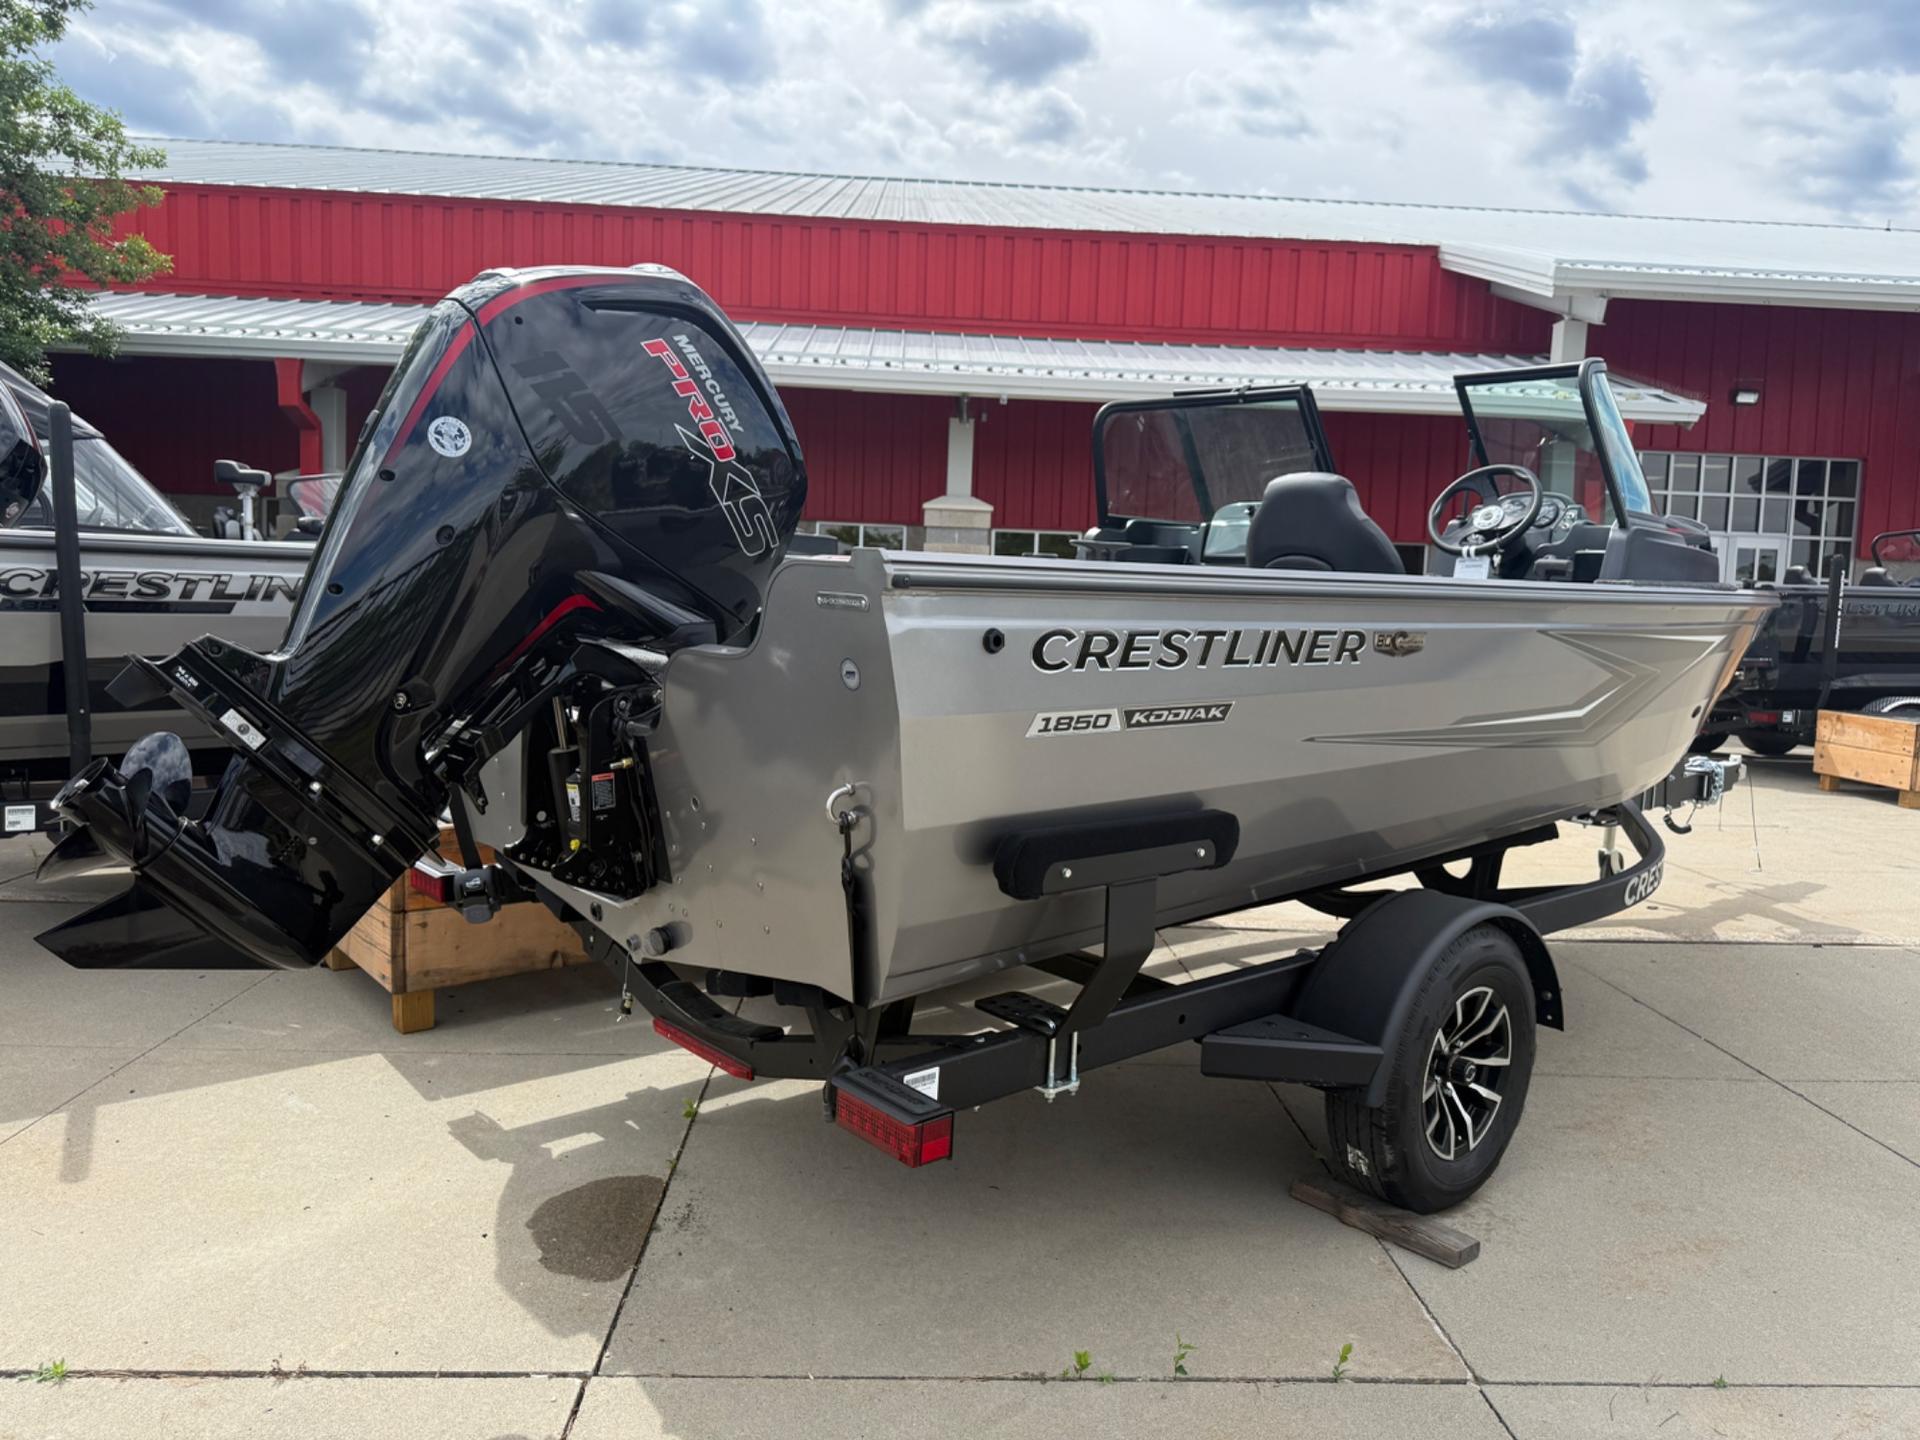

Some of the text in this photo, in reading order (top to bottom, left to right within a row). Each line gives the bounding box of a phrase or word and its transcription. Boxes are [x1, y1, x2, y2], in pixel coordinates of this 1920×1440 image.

[511, 350, 624, 446] 115
[672, 334, 744, 433] MERCURY
[640, 338, 780, 557] PRO XS
[1031, 629, 1366, 673] CRESTLINER
[1037, 705, 1225, 733] 1850 KODIAK
